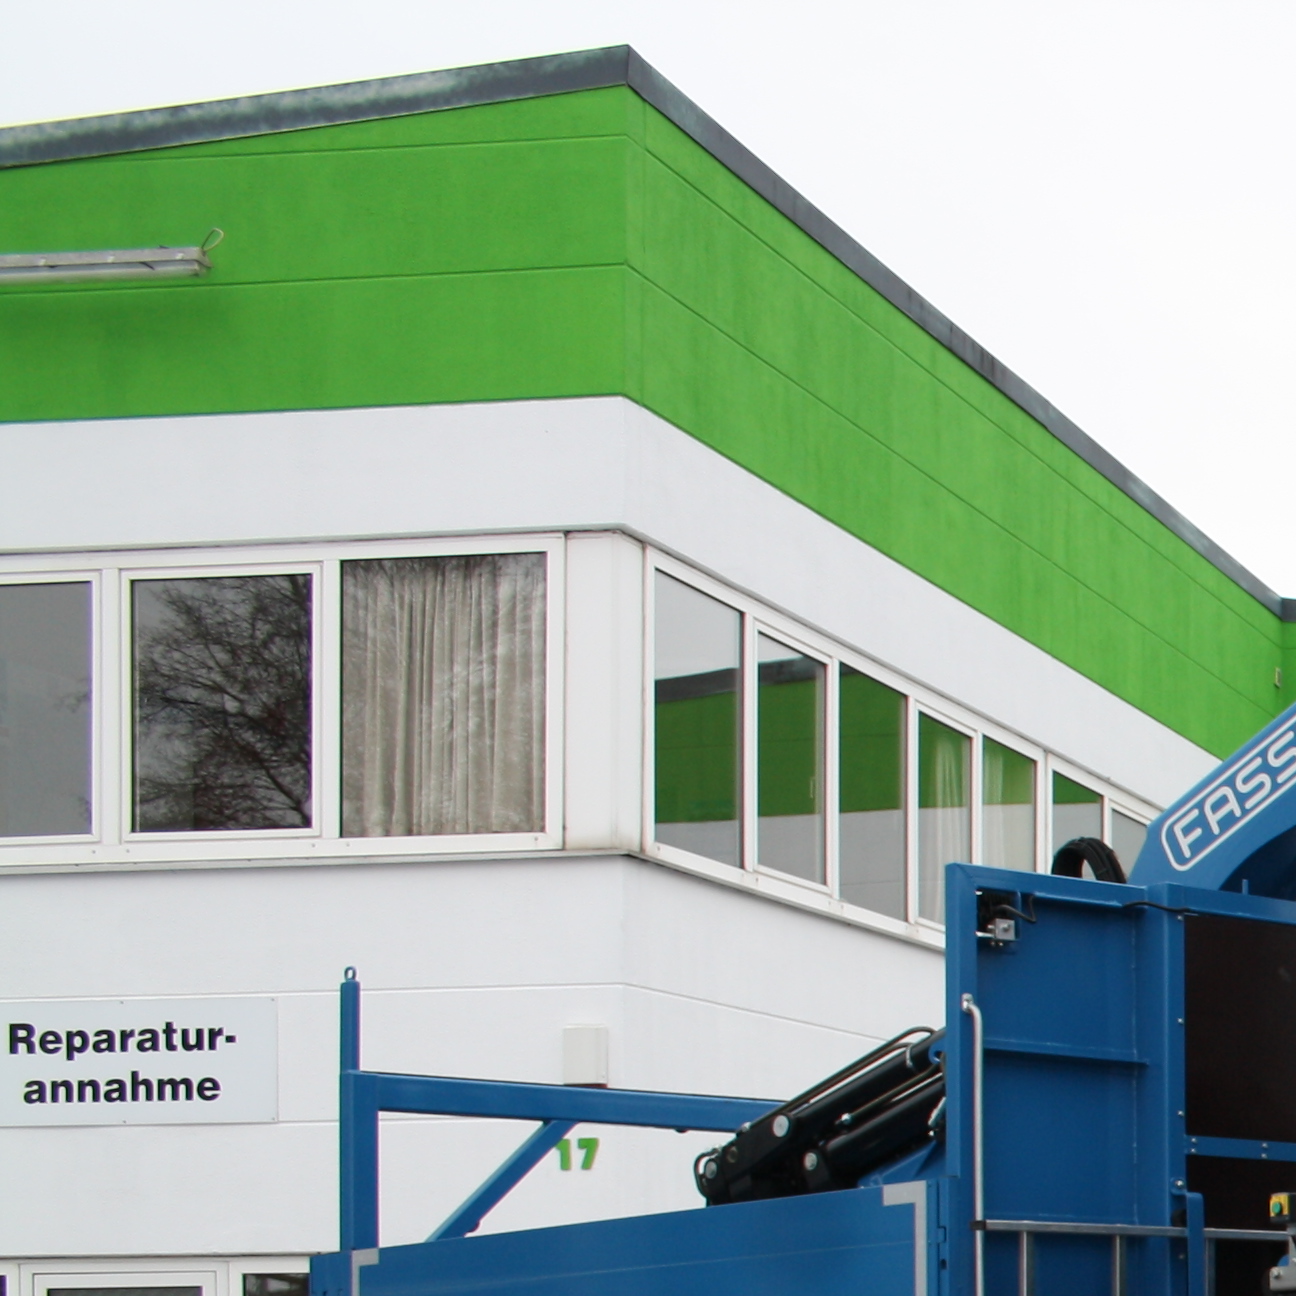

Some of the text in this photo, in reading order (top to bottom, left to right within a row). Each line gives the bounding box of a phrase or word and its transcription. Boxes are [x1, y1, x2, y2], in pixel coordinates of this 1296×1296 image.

[9, 1021, 237, 1061] Reparatur-
[23, 1071, 222, 1104] annahme
[556, 1137, 600, 1171] 17
